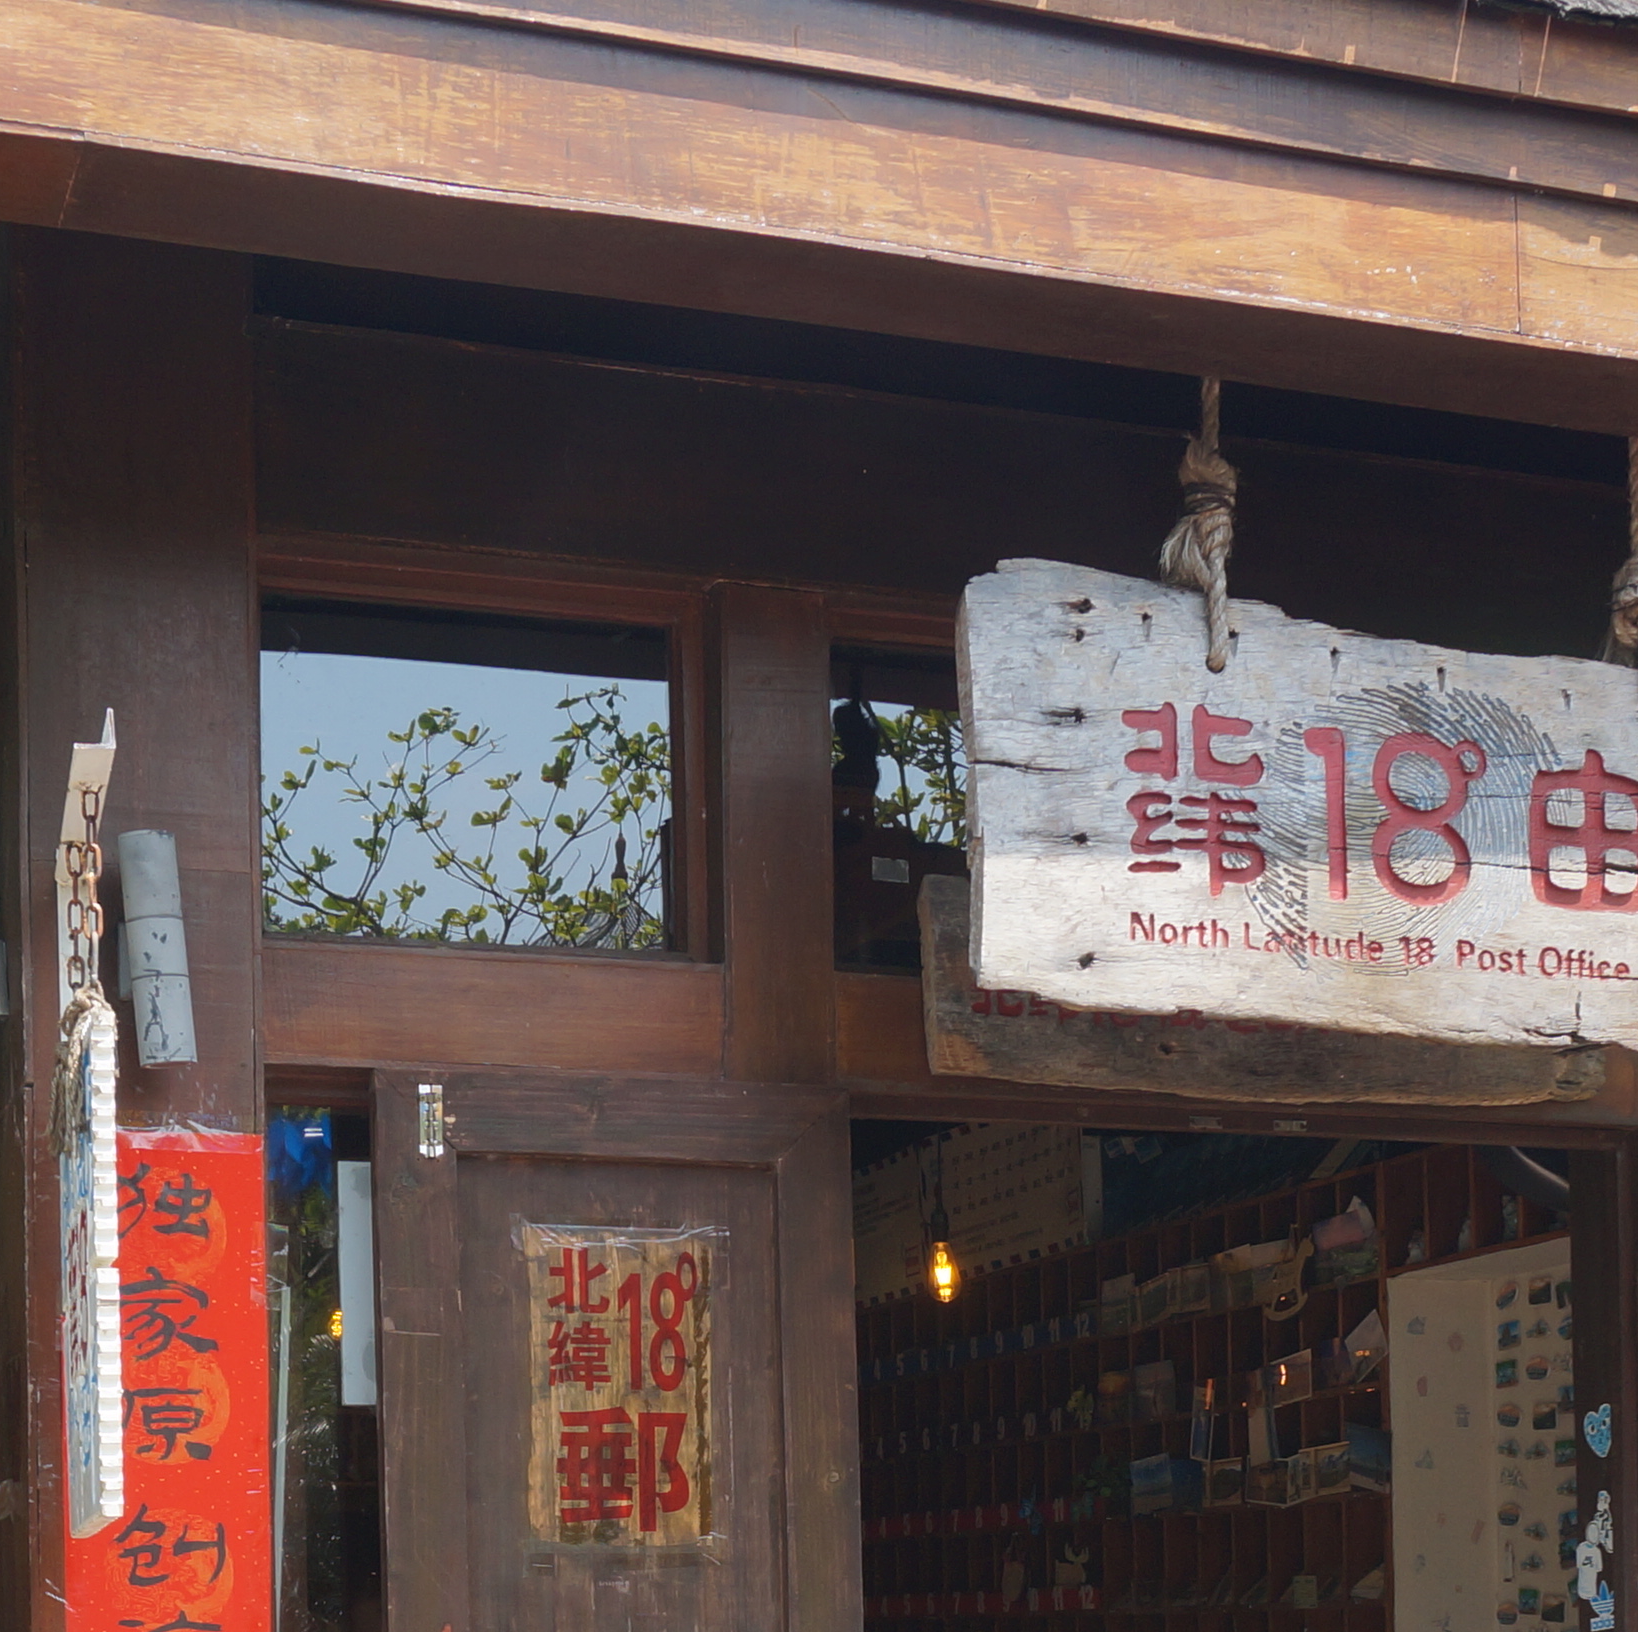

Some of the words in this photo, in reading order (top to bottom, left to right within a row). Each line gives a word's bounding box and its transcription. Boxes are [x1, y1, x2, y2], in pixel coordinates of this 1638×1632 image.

[1129, 911, 1230, 949] North
[1399, 935, 1436, 966] 18
[1455, 939, 1528, 977] Post
[1538, 946, 1630, 982] Office
[994, 1331, 1003, 1354] 9
[1021, 1323, 1034, 1350] 10
[1048, 1316, 1060, 1342] 11
[1074, 1312, 1090, 1338] 12
[997, 1416, 1005, 1440] 9
[1023, 1412, 1036, 1440] 10
[1049, 1407, 1062, 1432] 11
[975, 1505, 983, 1528] 8
[1000, 1503, 1008, 1526] 9
[1052, 1497, 1064, 1522] 11
[1027, 1587, 1039, 1611] 10
[1052, 1586, 1064, 1610] 11
[1079, 1585, 1095, 1610] 12
